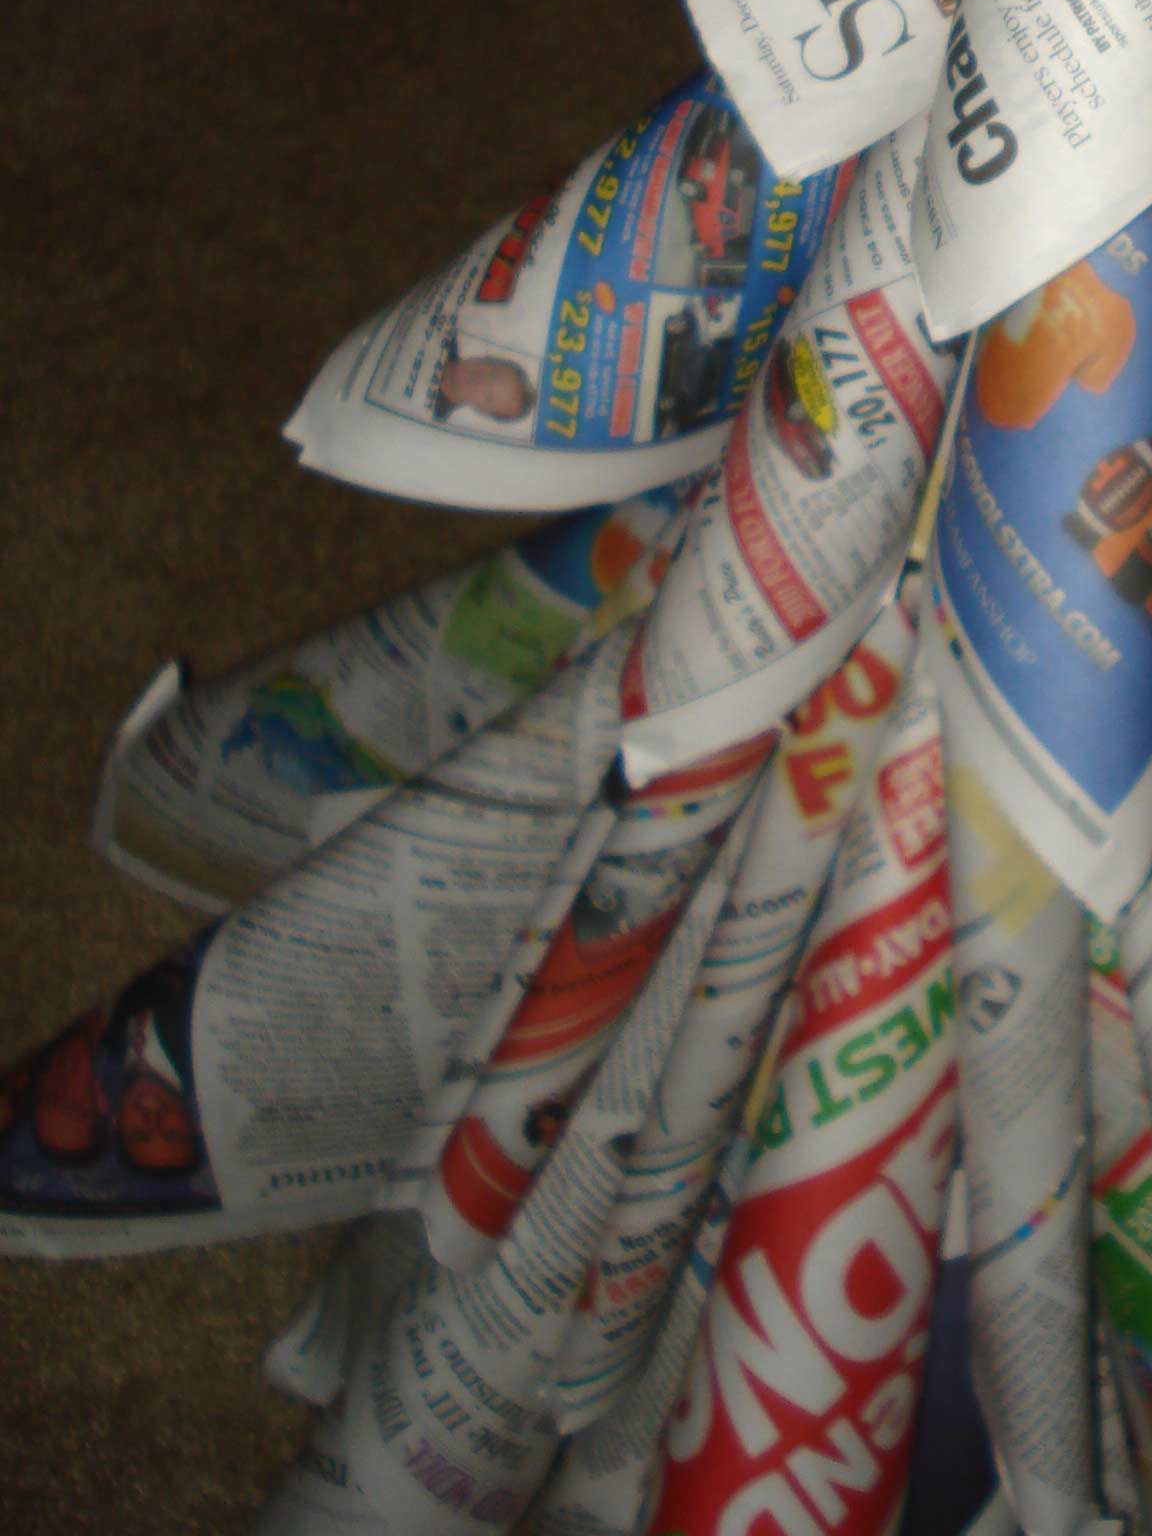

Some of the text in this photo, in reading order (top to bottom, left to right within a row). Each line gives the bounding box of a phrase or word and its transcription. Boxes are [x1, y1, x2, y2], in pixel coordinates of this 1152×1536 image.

[1024, 9, 1109, 116] schedule
[1090, 30, 1113, 54] BY
[1024, 58, 1101, 151] Players
[813, 325, 897, 452] $20,177
